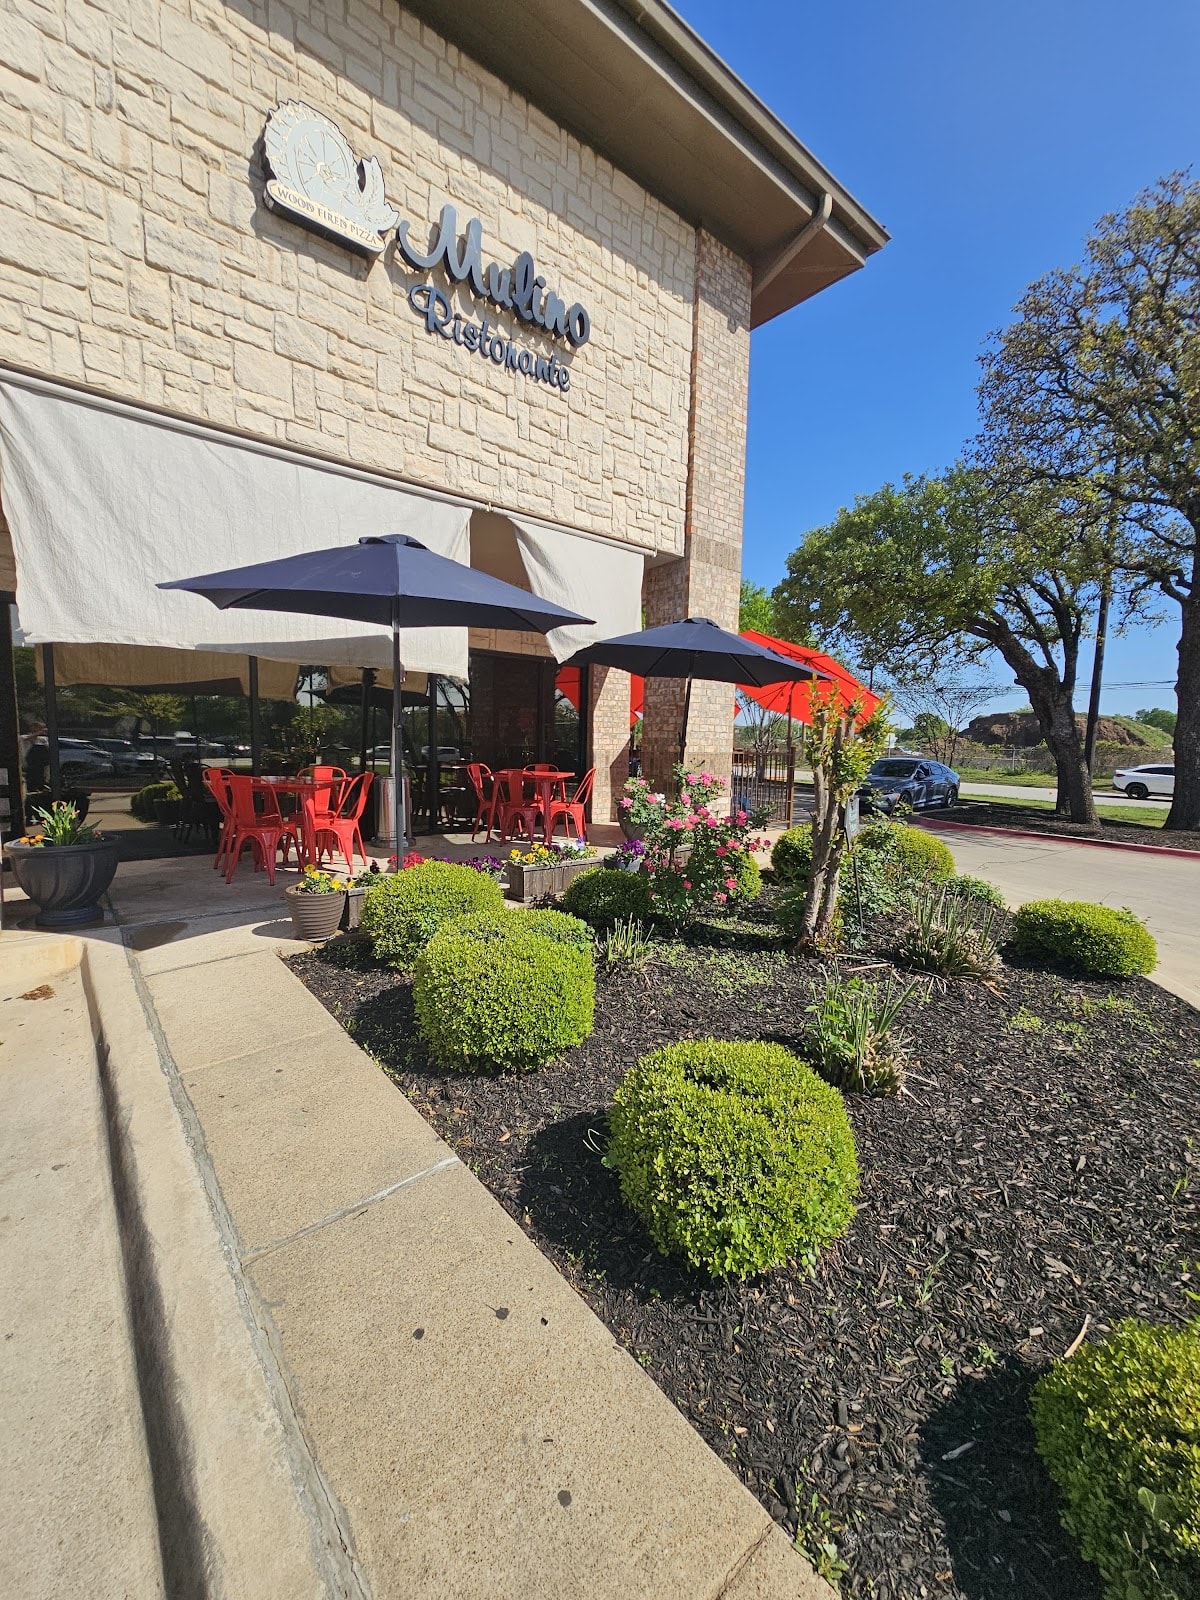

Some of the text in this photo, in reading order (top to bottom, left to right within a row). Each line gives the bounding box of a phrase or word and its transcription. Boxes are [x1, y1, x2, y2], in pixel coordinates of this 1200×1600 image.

[277, 186, 378, 246] WOOD FIRED PIZZA
[397, 204, 590, 348] Mulino
[409, 283, 571, 392] Ristorante
